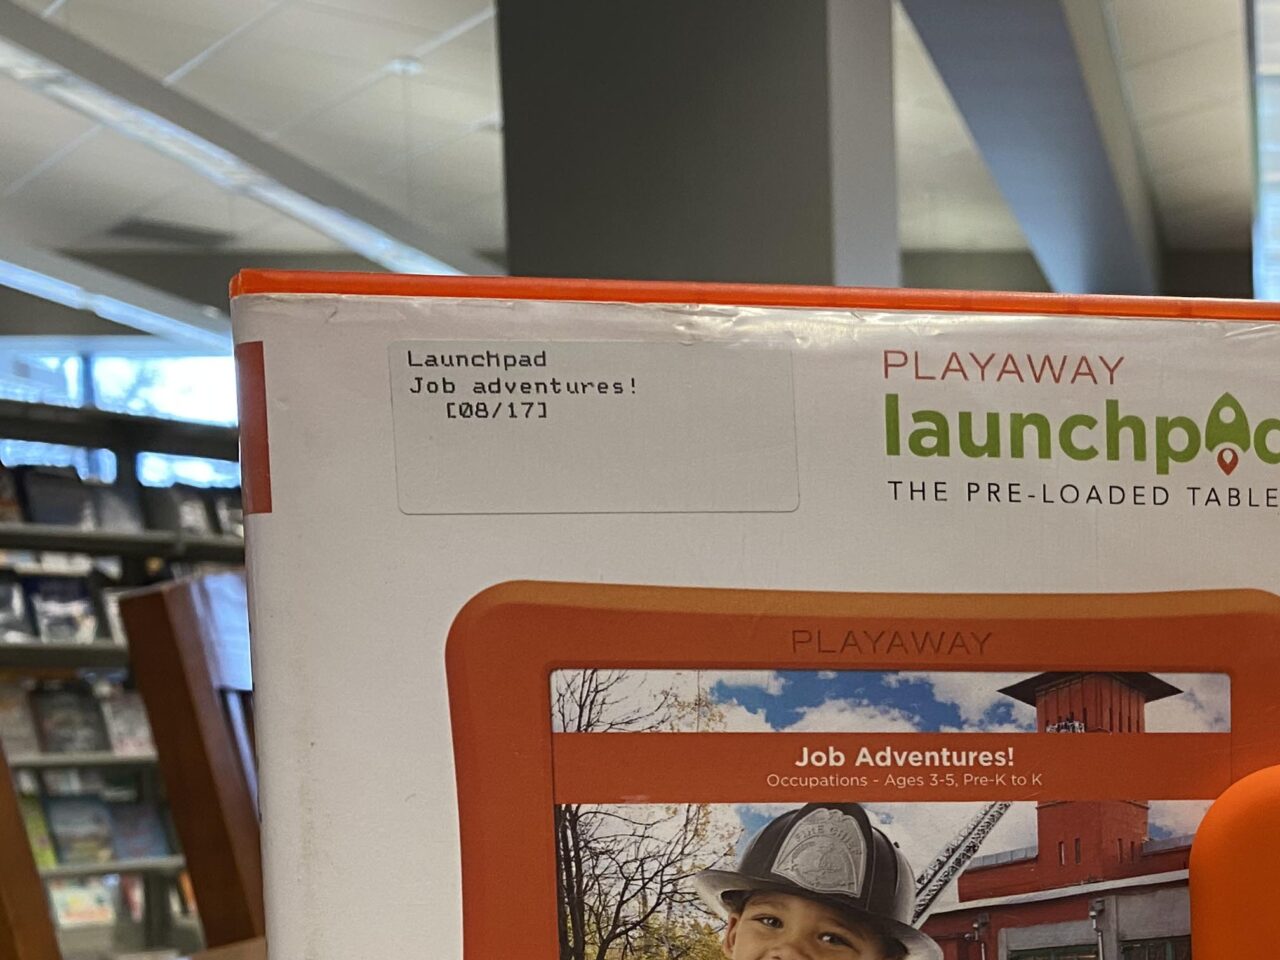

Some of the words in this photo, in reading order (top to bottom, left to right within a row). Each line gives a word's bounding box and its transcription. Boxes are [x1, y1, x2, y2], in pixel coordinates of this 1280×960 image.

[407, 350, 547, 371] Launchpad
[883, 350, 1125, 385] PLAYAWAY
[409, 377, 456, 394] Job
[473, 377, 638, 394] adventures!
[446, 402, 548, 419] [08/17]
[887, 480, 947, 502] THE
[967, 482, 1170, 506] PRE-LOADED
[791, 629, 993, 656] PLAYAWAY
[795, 746, 846, 768] Job
[855, 746, 1015, 768] Adventures!
[766, 773, 868, 790] Occupations
[884, 773, 926, 790] Ages
[929, 773, 959, 788] 3-5,
[963, 773, 1007, 787] Pre-K
[1011, 774, 1027, 787] to
[1031, 773, 1043, 786] K
